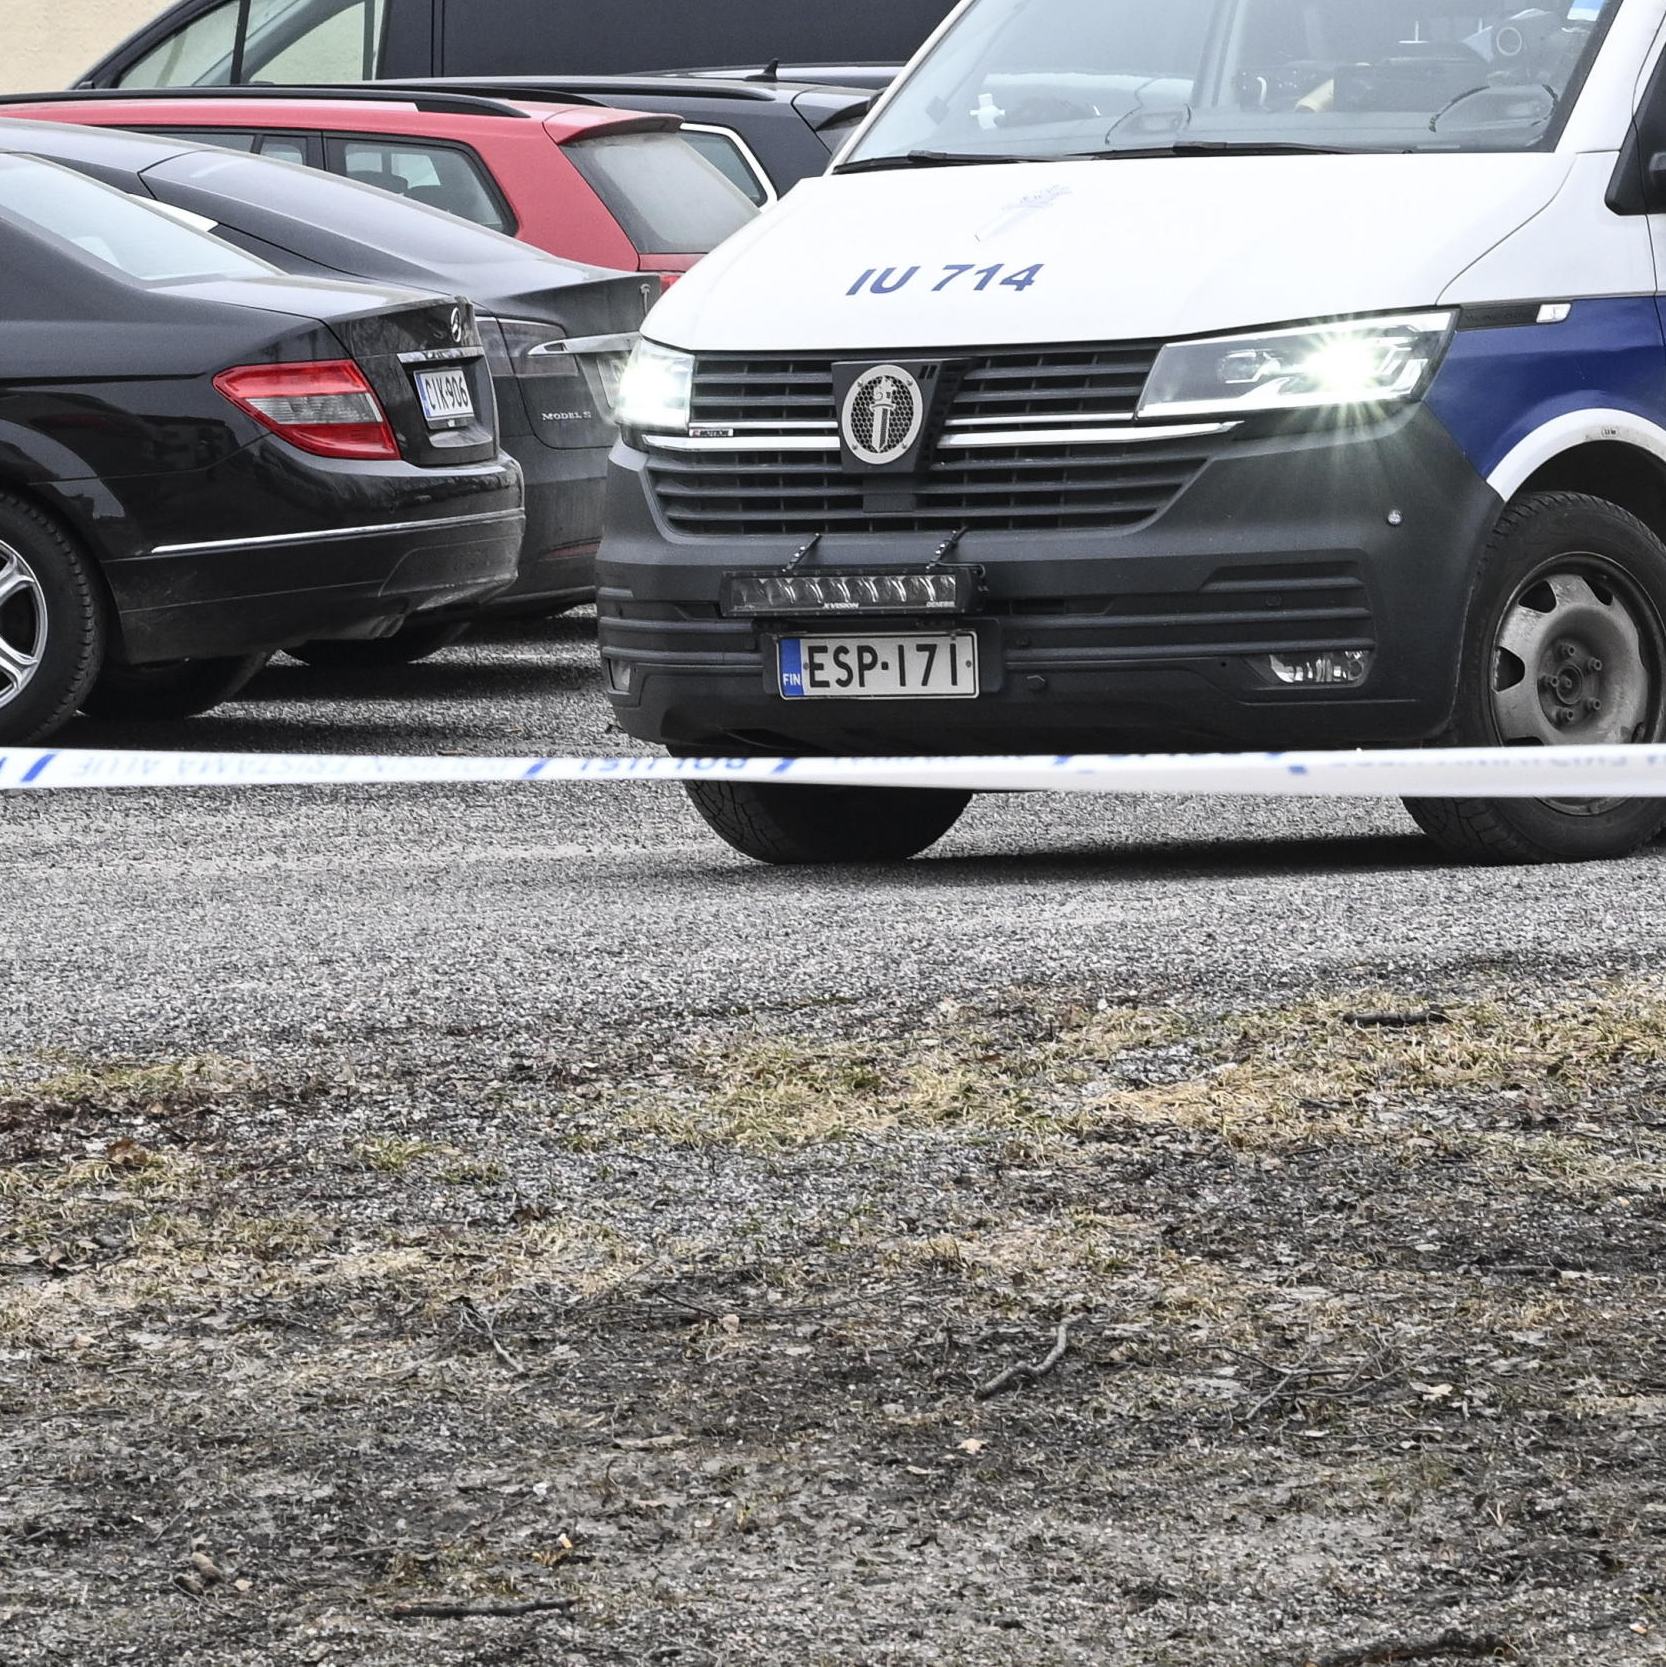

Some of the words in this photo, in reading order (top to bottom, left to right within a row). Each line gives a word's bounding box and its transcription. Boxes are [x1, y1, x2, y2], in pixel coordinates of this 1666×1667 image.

[846, 265, 921, 296] IU
[931, 263, 1044, 292] 714
[541, 411, 582, 421] MODEL
[583, 411, 592, 419] S
[807, 642, 958, 688] ESP-171
[782, 673, 801, 686] FIN
